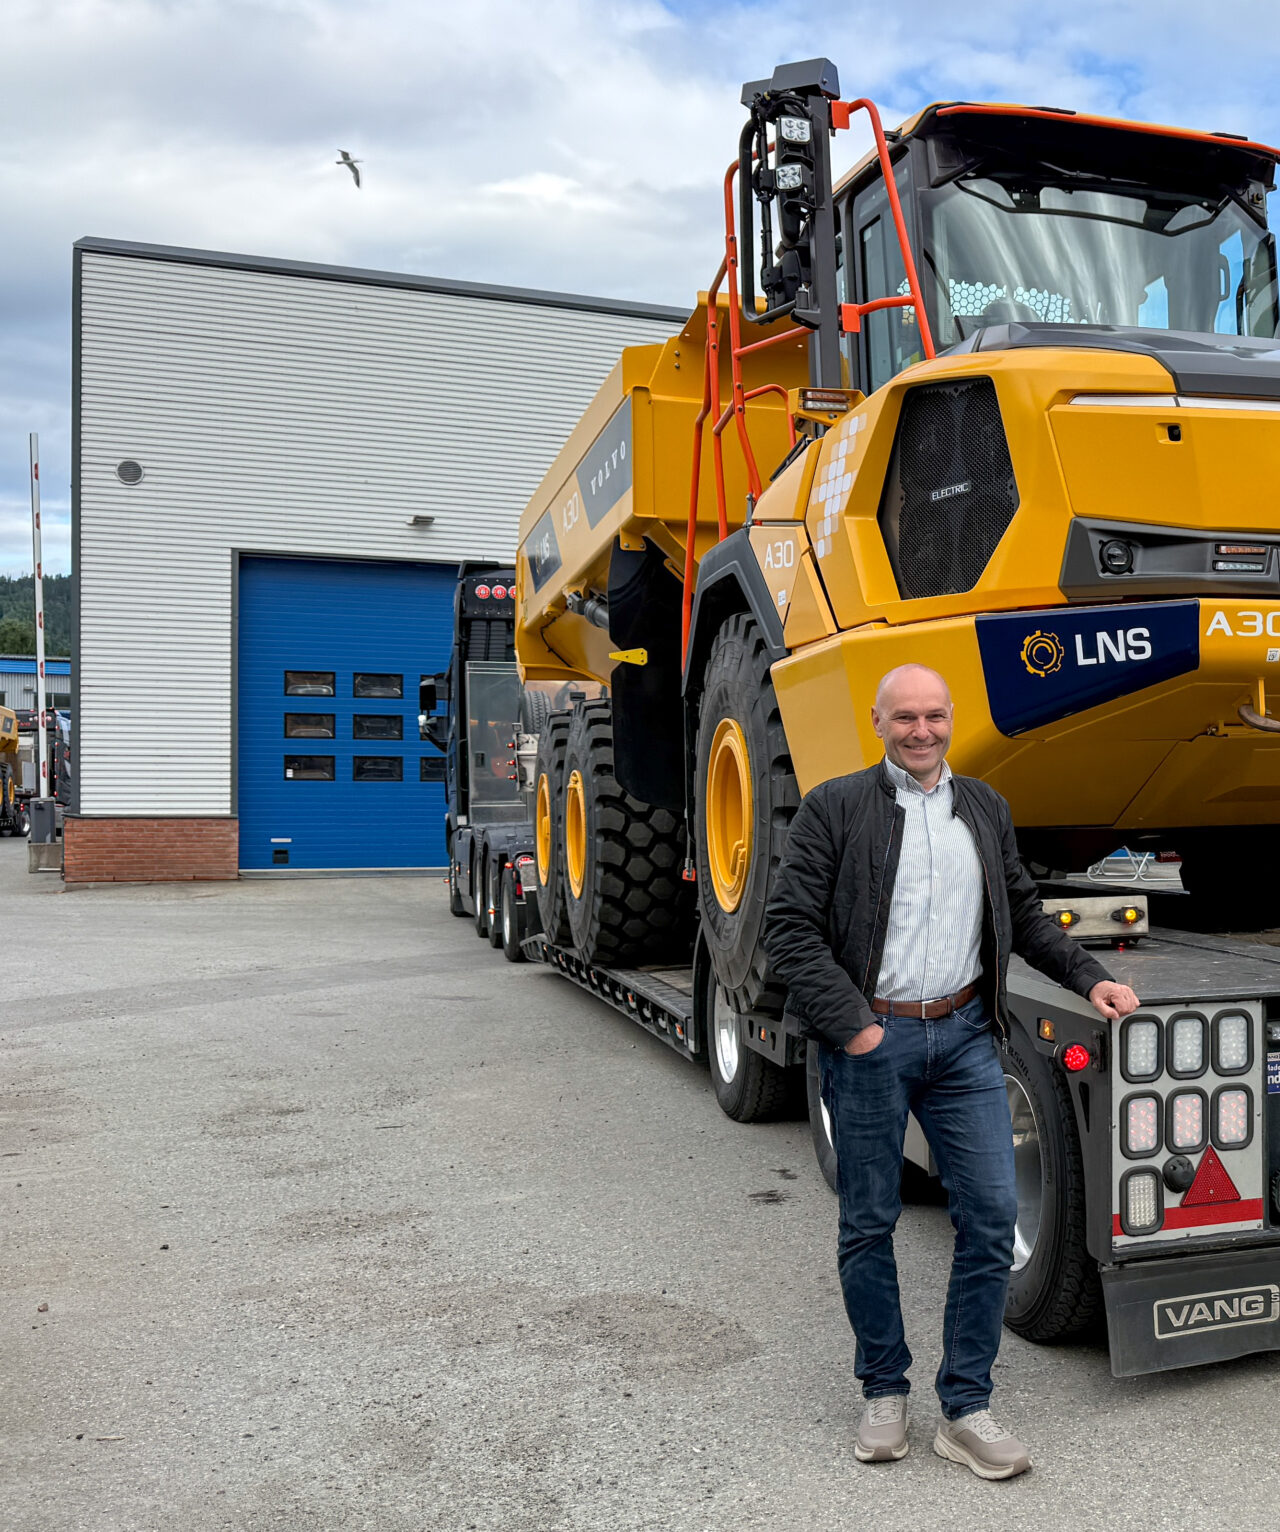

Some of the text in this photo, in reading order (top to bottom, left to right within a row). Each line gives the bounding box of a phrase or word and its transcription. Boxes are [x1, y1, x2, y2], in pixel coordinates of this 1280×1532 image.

[590, 440, 626, 496] VOLVO
[932, 482, 969, 500] ELECTRIC
[562, 491, 580, 537] A30
[764, 540, 794, 569] A30
[1075, 627, 1152, 666] LNS
[1165, 1294, 1265, 1328] VANG
